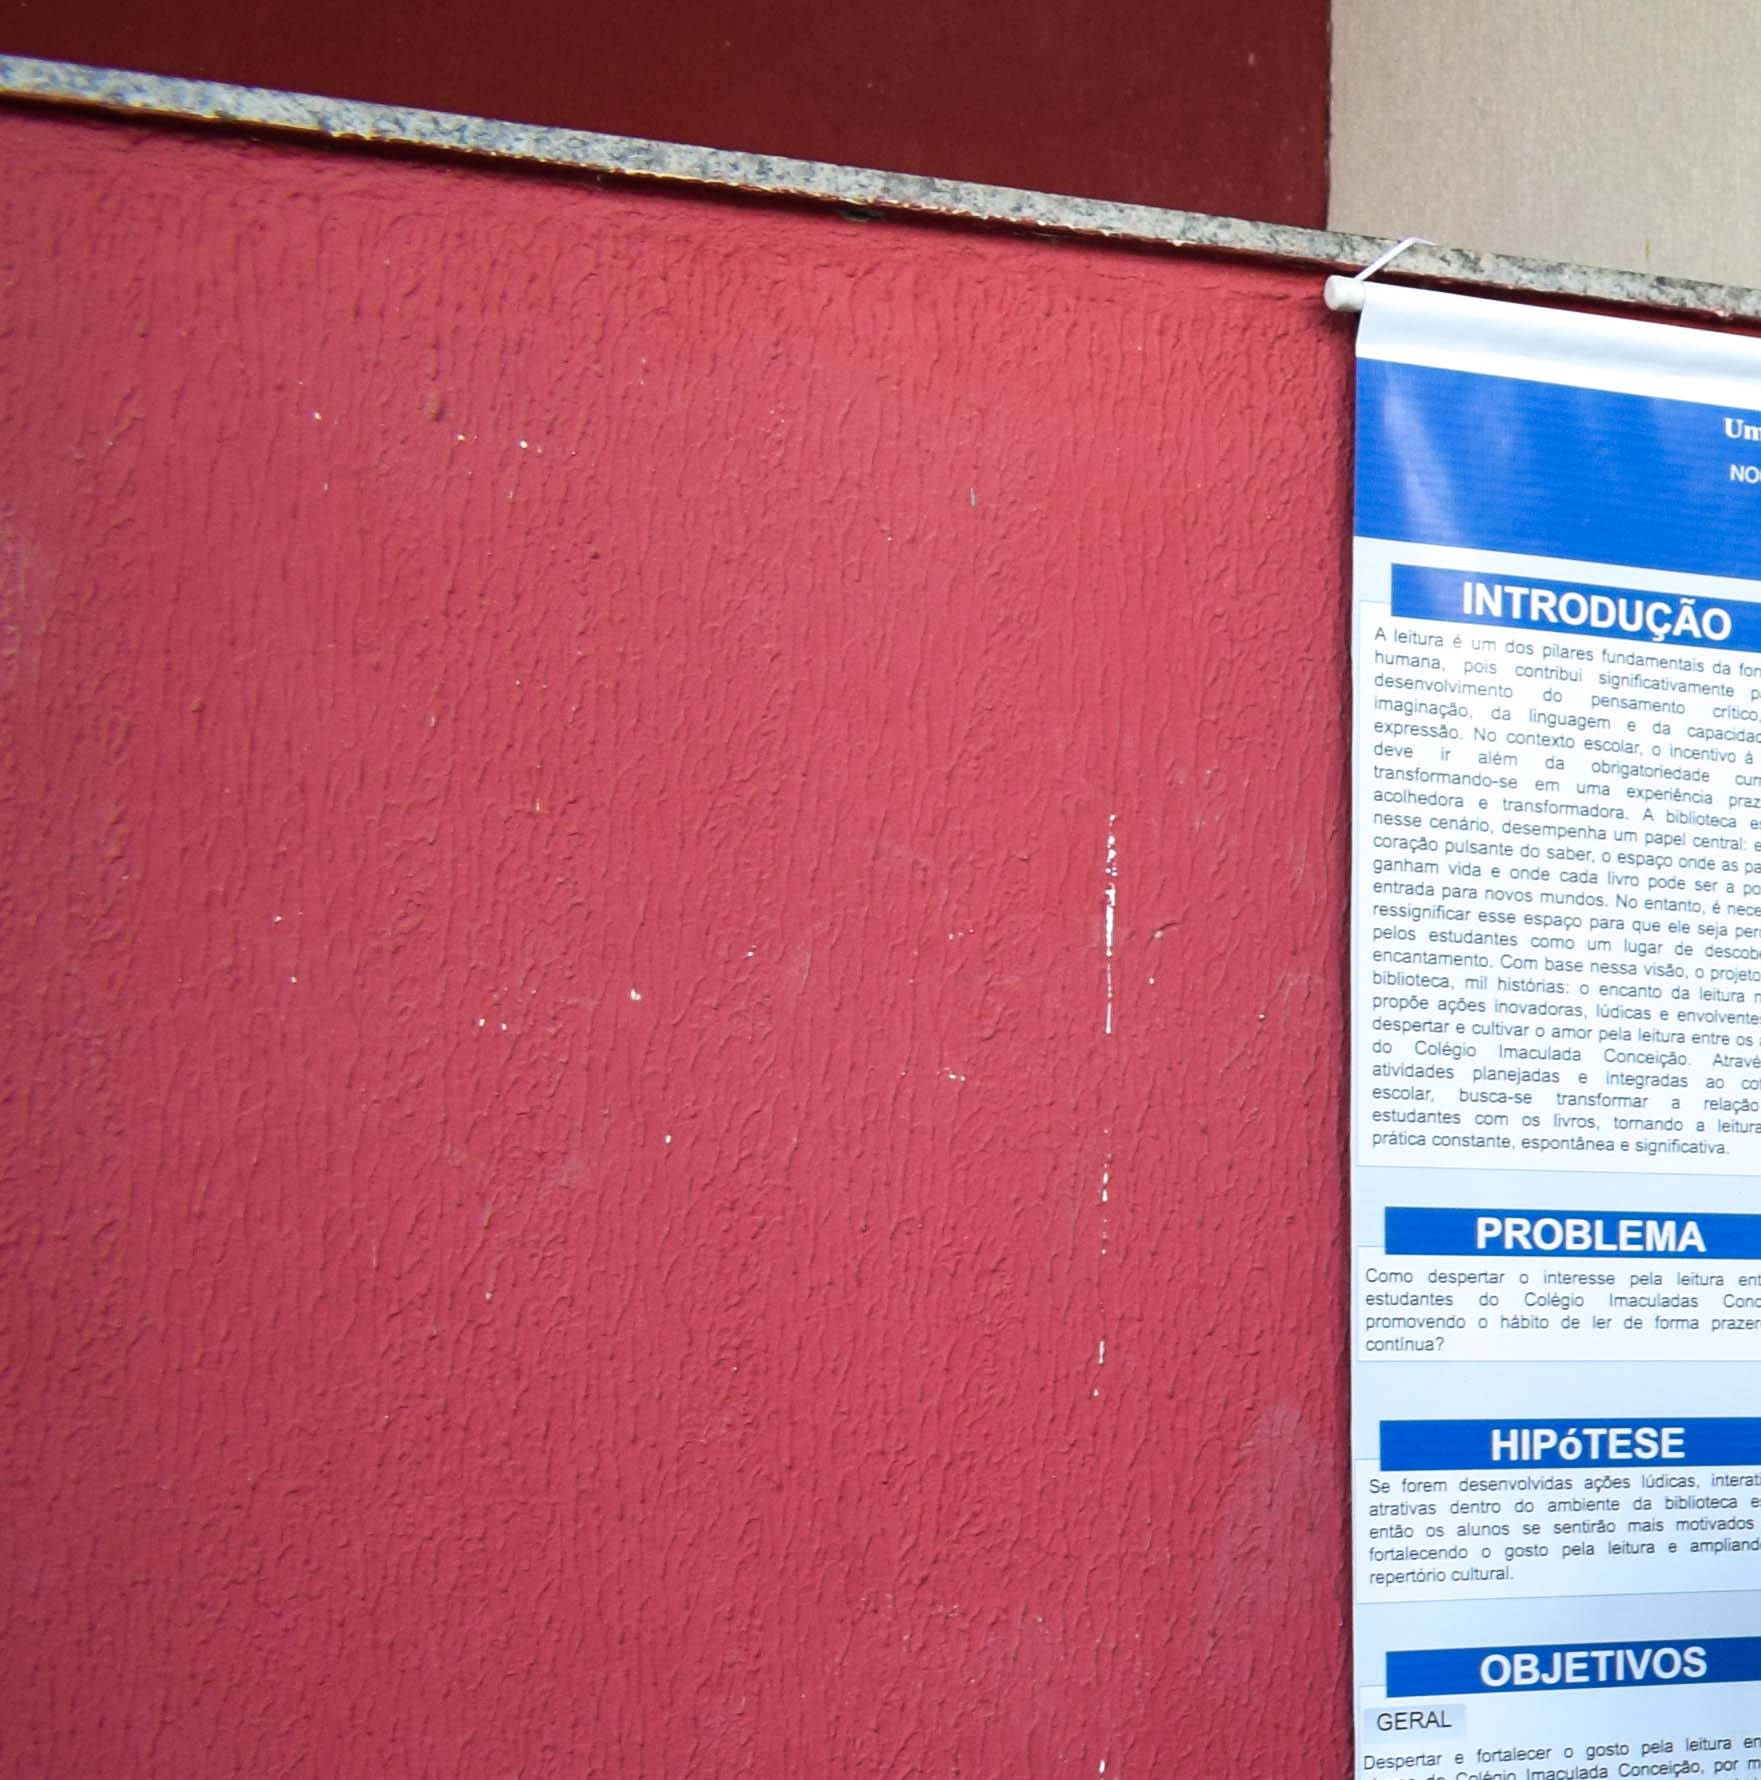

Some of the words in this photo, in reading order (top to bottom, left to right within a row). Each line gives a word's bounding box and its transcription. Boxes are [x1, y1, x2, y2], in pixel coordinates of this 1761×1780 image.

[1463, 581, 1732, 642] INTRODUÇÃO
[1374, 651, 1445, 672] humana,
[1463, 661, 1497, 675] pois
[1514, 665, 1582, 682] contribui
[1599, 671, 1735, 698] significativamente
[1373, 904, 1471, 922] ressignificar
[1477, 911, 1516, 924] esse
[1523, 913, 1582, 931] espaço
[1589, 917, 1624, 931] para
[1631, 920, 1661, 934] que
[1667, 920, 1691, 934] ele
[1697, 924, 1728, 940] seja
[1372, 1130, 1426, 1147] prática
[1431, 1134, 1515, 1149] constante,
[1521, 1136, 1615, 1152] espontânea
[1620, 1140, 1630, 1152] e
[1635, 1138, 1729, 1156] significativa.
[1476, 1216, 1706, 1252] PROBLEMA
[1365, 1291, 1453, 1306] estudantes
[1478, 1292, 1499, 1306] do
[1524, 1291, 1584, 1311] Colégio
[1609, 1293, 1698, 1308] Imaculadas
[1369, 1524, 1414, 1539] então
[1425, 1526, 1444, 1537] os
[1456, 1522, 1510, 1537] alunos
[1522, 1523, 1541, 1535] se
[1553, 1519, 1616, 1535] sentirão
[1627, 1517, 1664, 1532] mais
[1676, 1516, 1754, 1531] motivados
[1480, 1646, 1707, 1687] OBJETIVOS
[1376, 1710, 1452, 1731] GERAL
